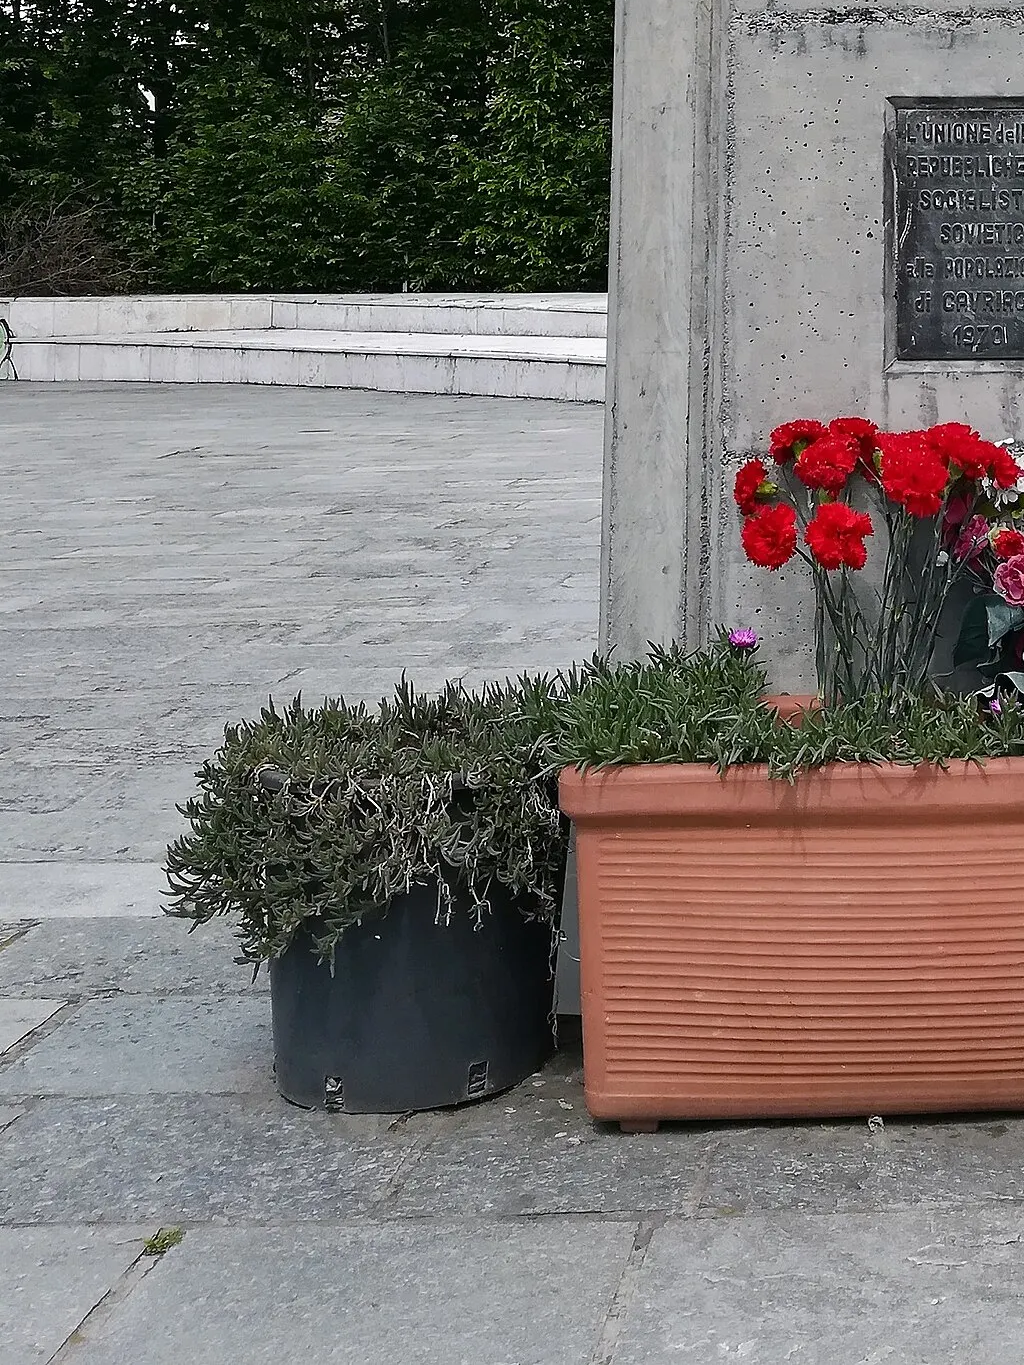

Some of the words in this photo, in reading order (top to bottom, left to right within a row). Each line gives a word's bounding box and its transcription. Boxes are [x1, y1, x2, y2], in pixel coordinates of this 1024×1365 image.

[906, 257, 934, 279] alla
[914, 290, 932, 312] di
[952, 324, 1005, 347] 1970
